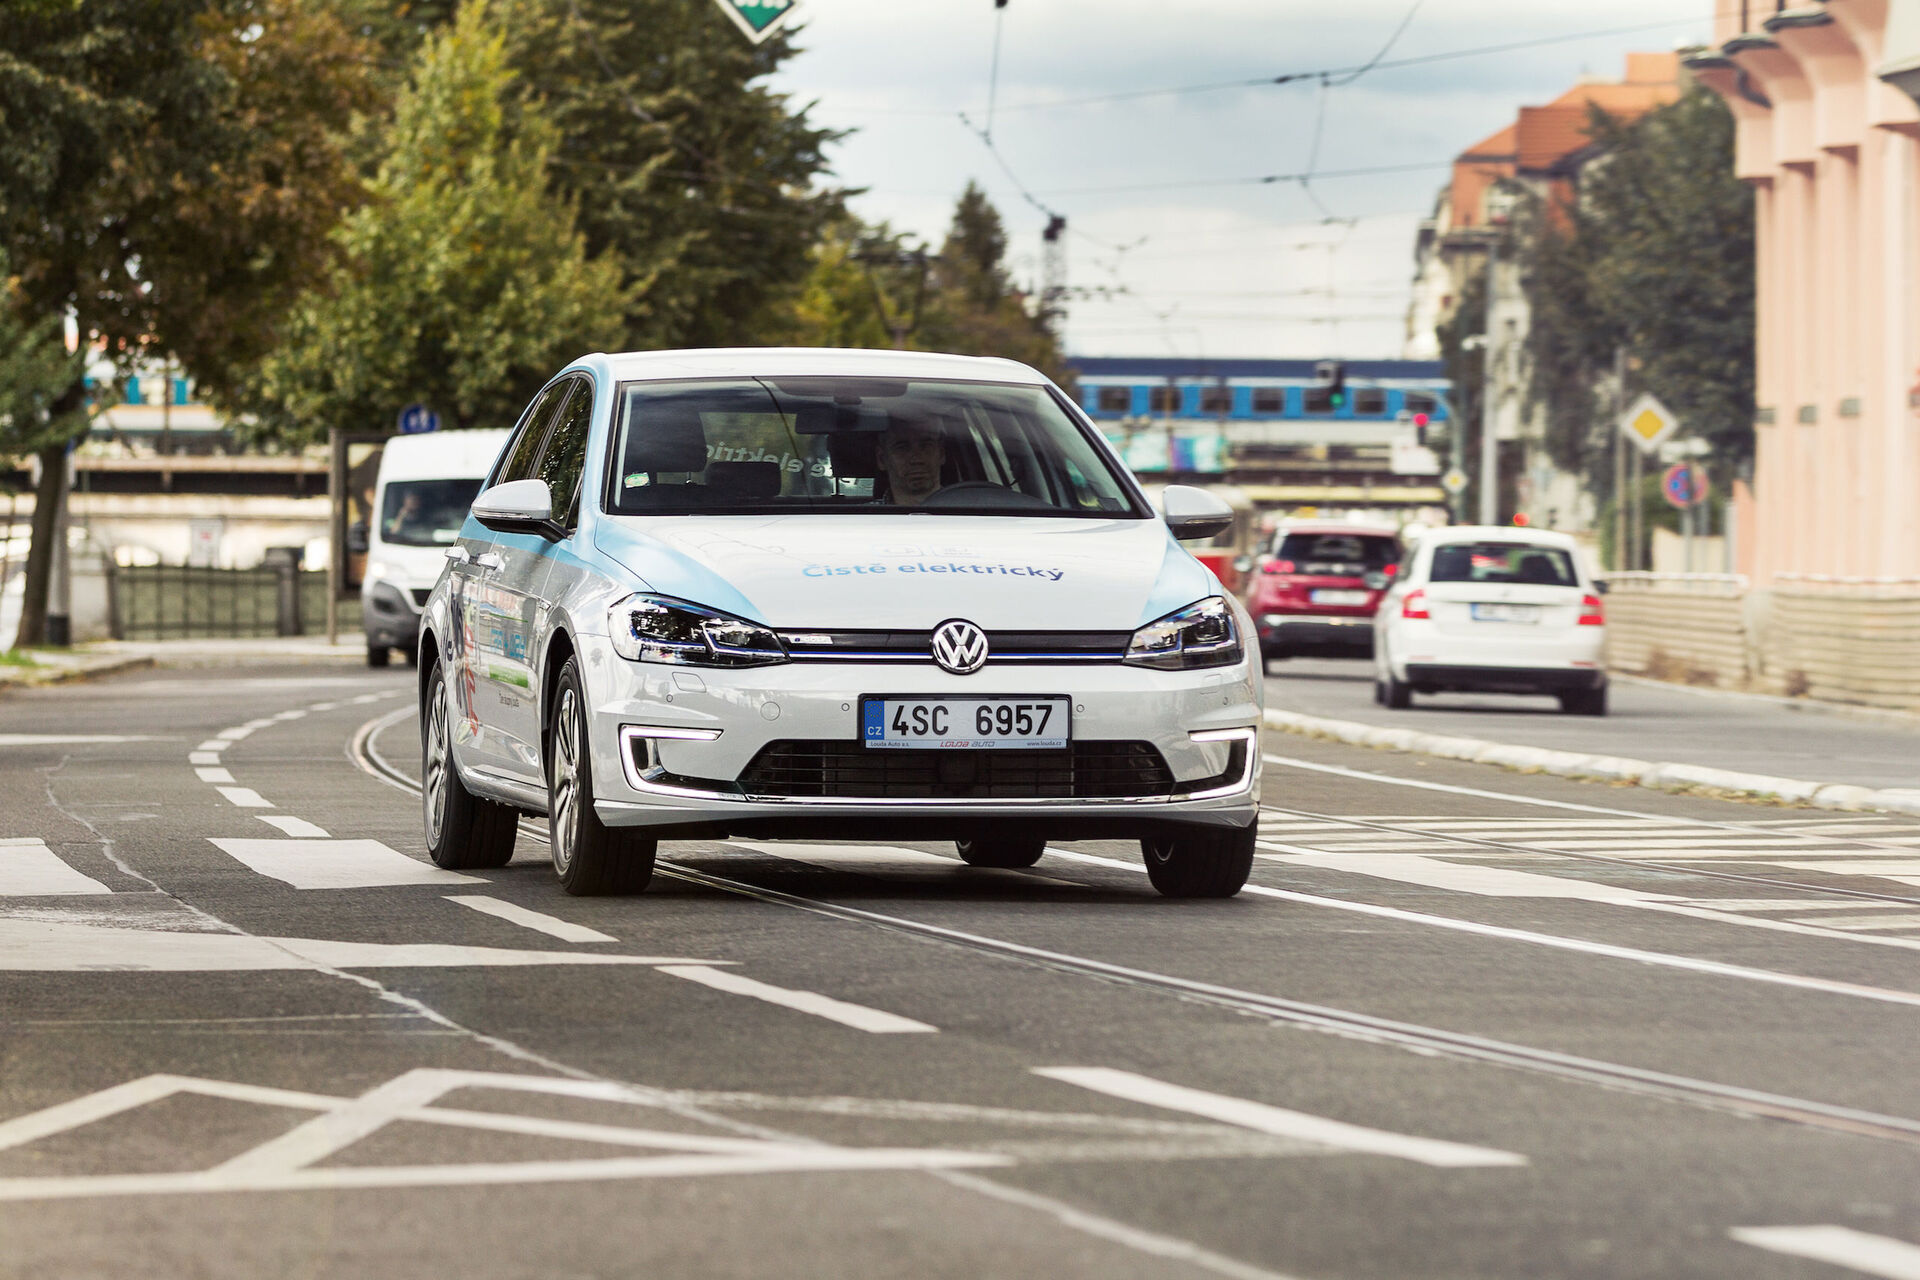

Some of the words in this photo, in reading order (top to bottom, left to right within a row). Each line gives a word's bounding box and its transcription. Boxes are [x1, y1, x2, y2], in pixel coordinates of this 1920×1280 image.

[802, 563, 887, 578] Čistě
[897, 562, 1065, 582] elektrický
[891, 704, 949, 736] 4SC
[975, 704, 1053, 736] 6957
[867, 726, 882, 736] CZ
